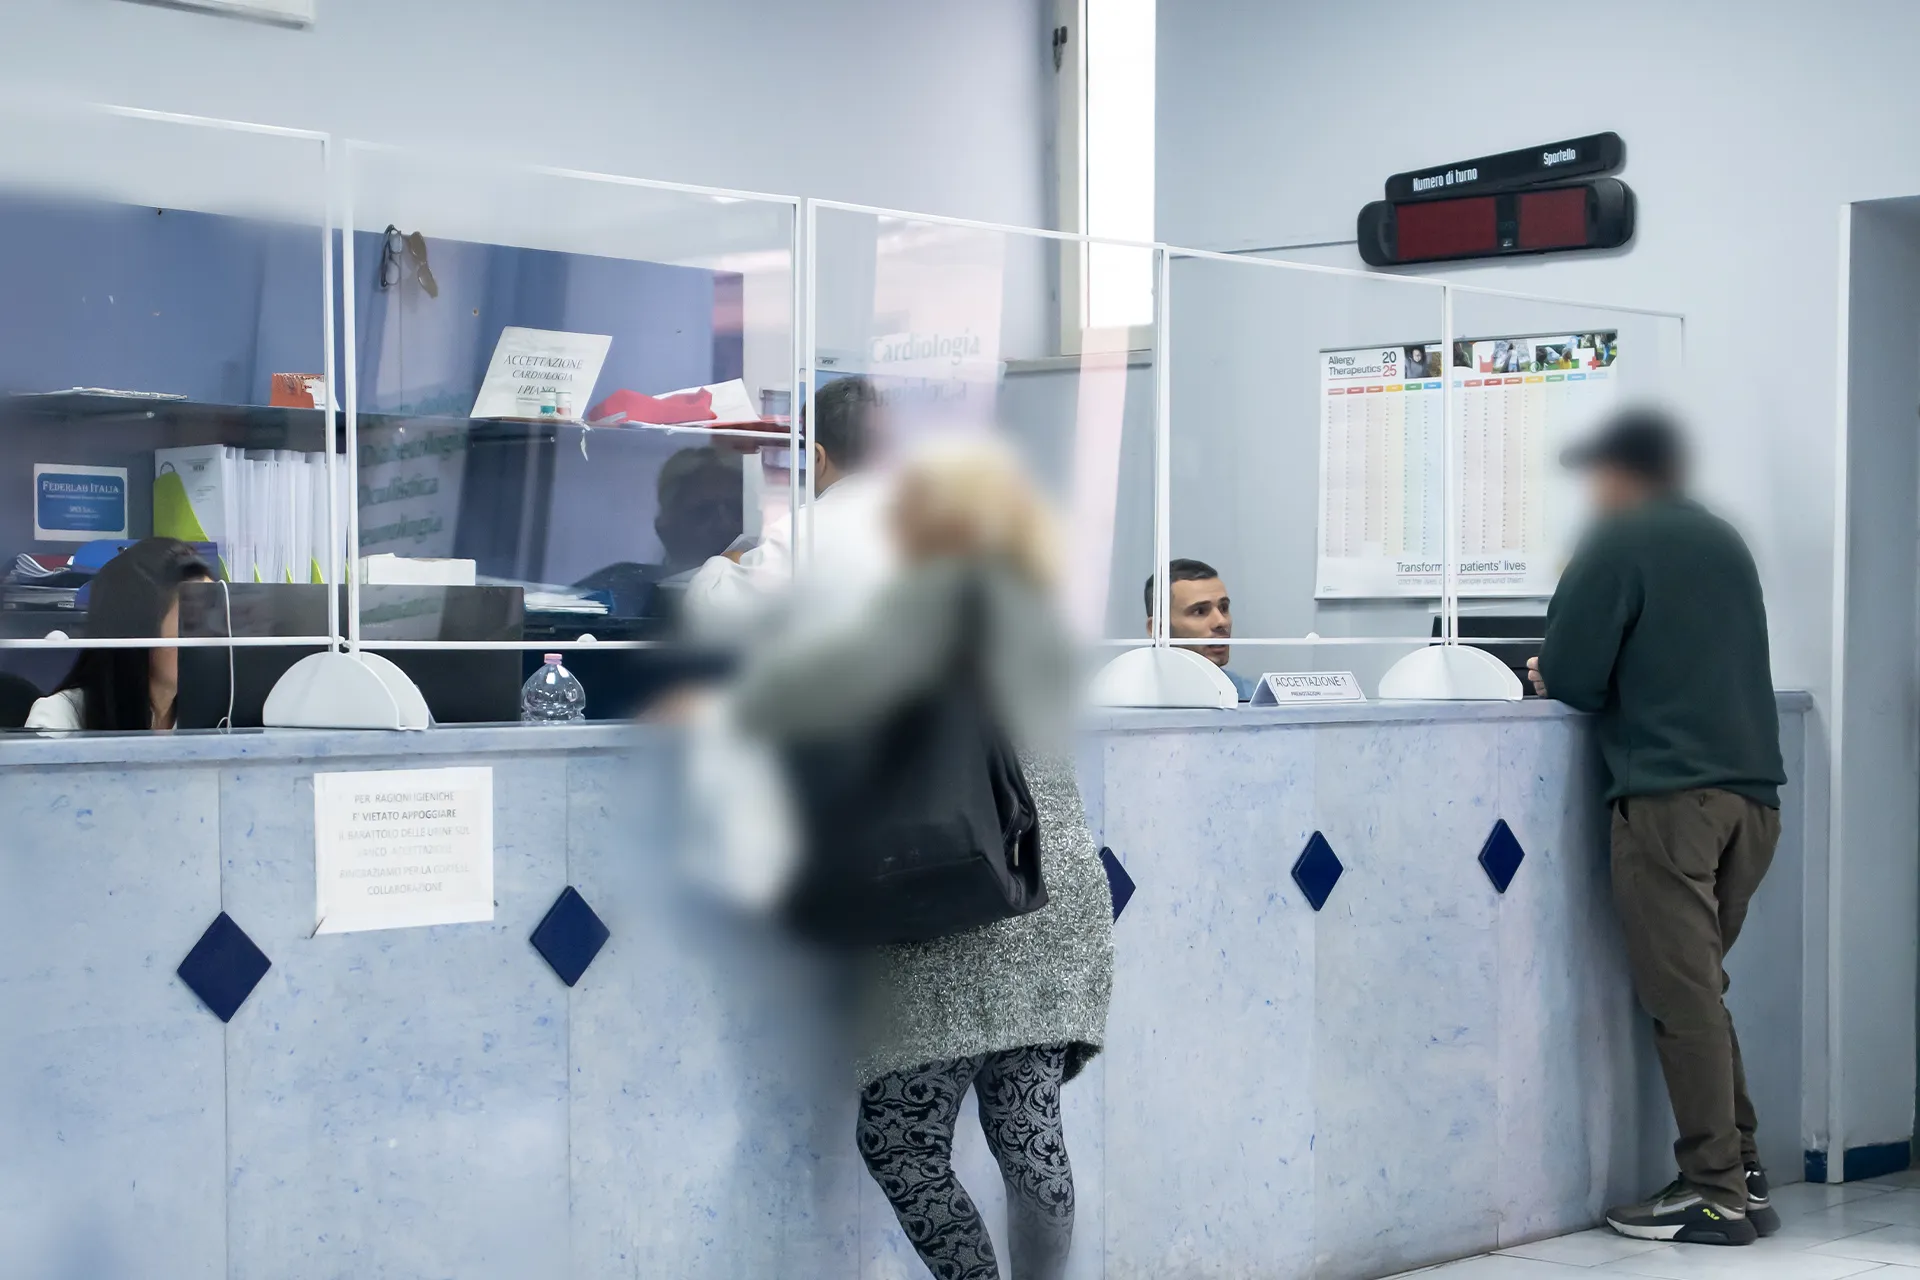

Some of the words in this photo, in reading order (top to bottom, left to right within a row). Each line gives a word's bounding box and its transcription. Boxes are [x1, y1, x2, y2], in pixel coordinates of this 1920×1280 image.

[1543, 148, 1576, 166] Sportello
[1413, 174, 1444, 192] Numero
[1445, 171, 1454, 185] di
[1455, 168, 1478, 183] turno
[504, 354, 584, 370] ACCETTAZIONE
[1328, 356, 1355, 366] Allergy
[1382, 351, 1397, 364] 20
[512, 369, 573, 382] CARDIOLOGIA
[1328, 365, 1382, 376] Therapeutics
[1382, 364, 1397, 377] 25
[1460, 560, 1501, 573] patients'
[1504, 560, 1527, 571] lives
[1275, 676, 1341, 687] ACCETTAZIONE
[354, 794, 371, 804] PER
[375, 793, 412, 804] RAGIONI
[413, 791, 455, 802] IGIENICHE
[362, 811, 399, 822] VIETATO
[401, 809, 457, 821] APPOGGIARE
[420, 865, 432, 875] LA
